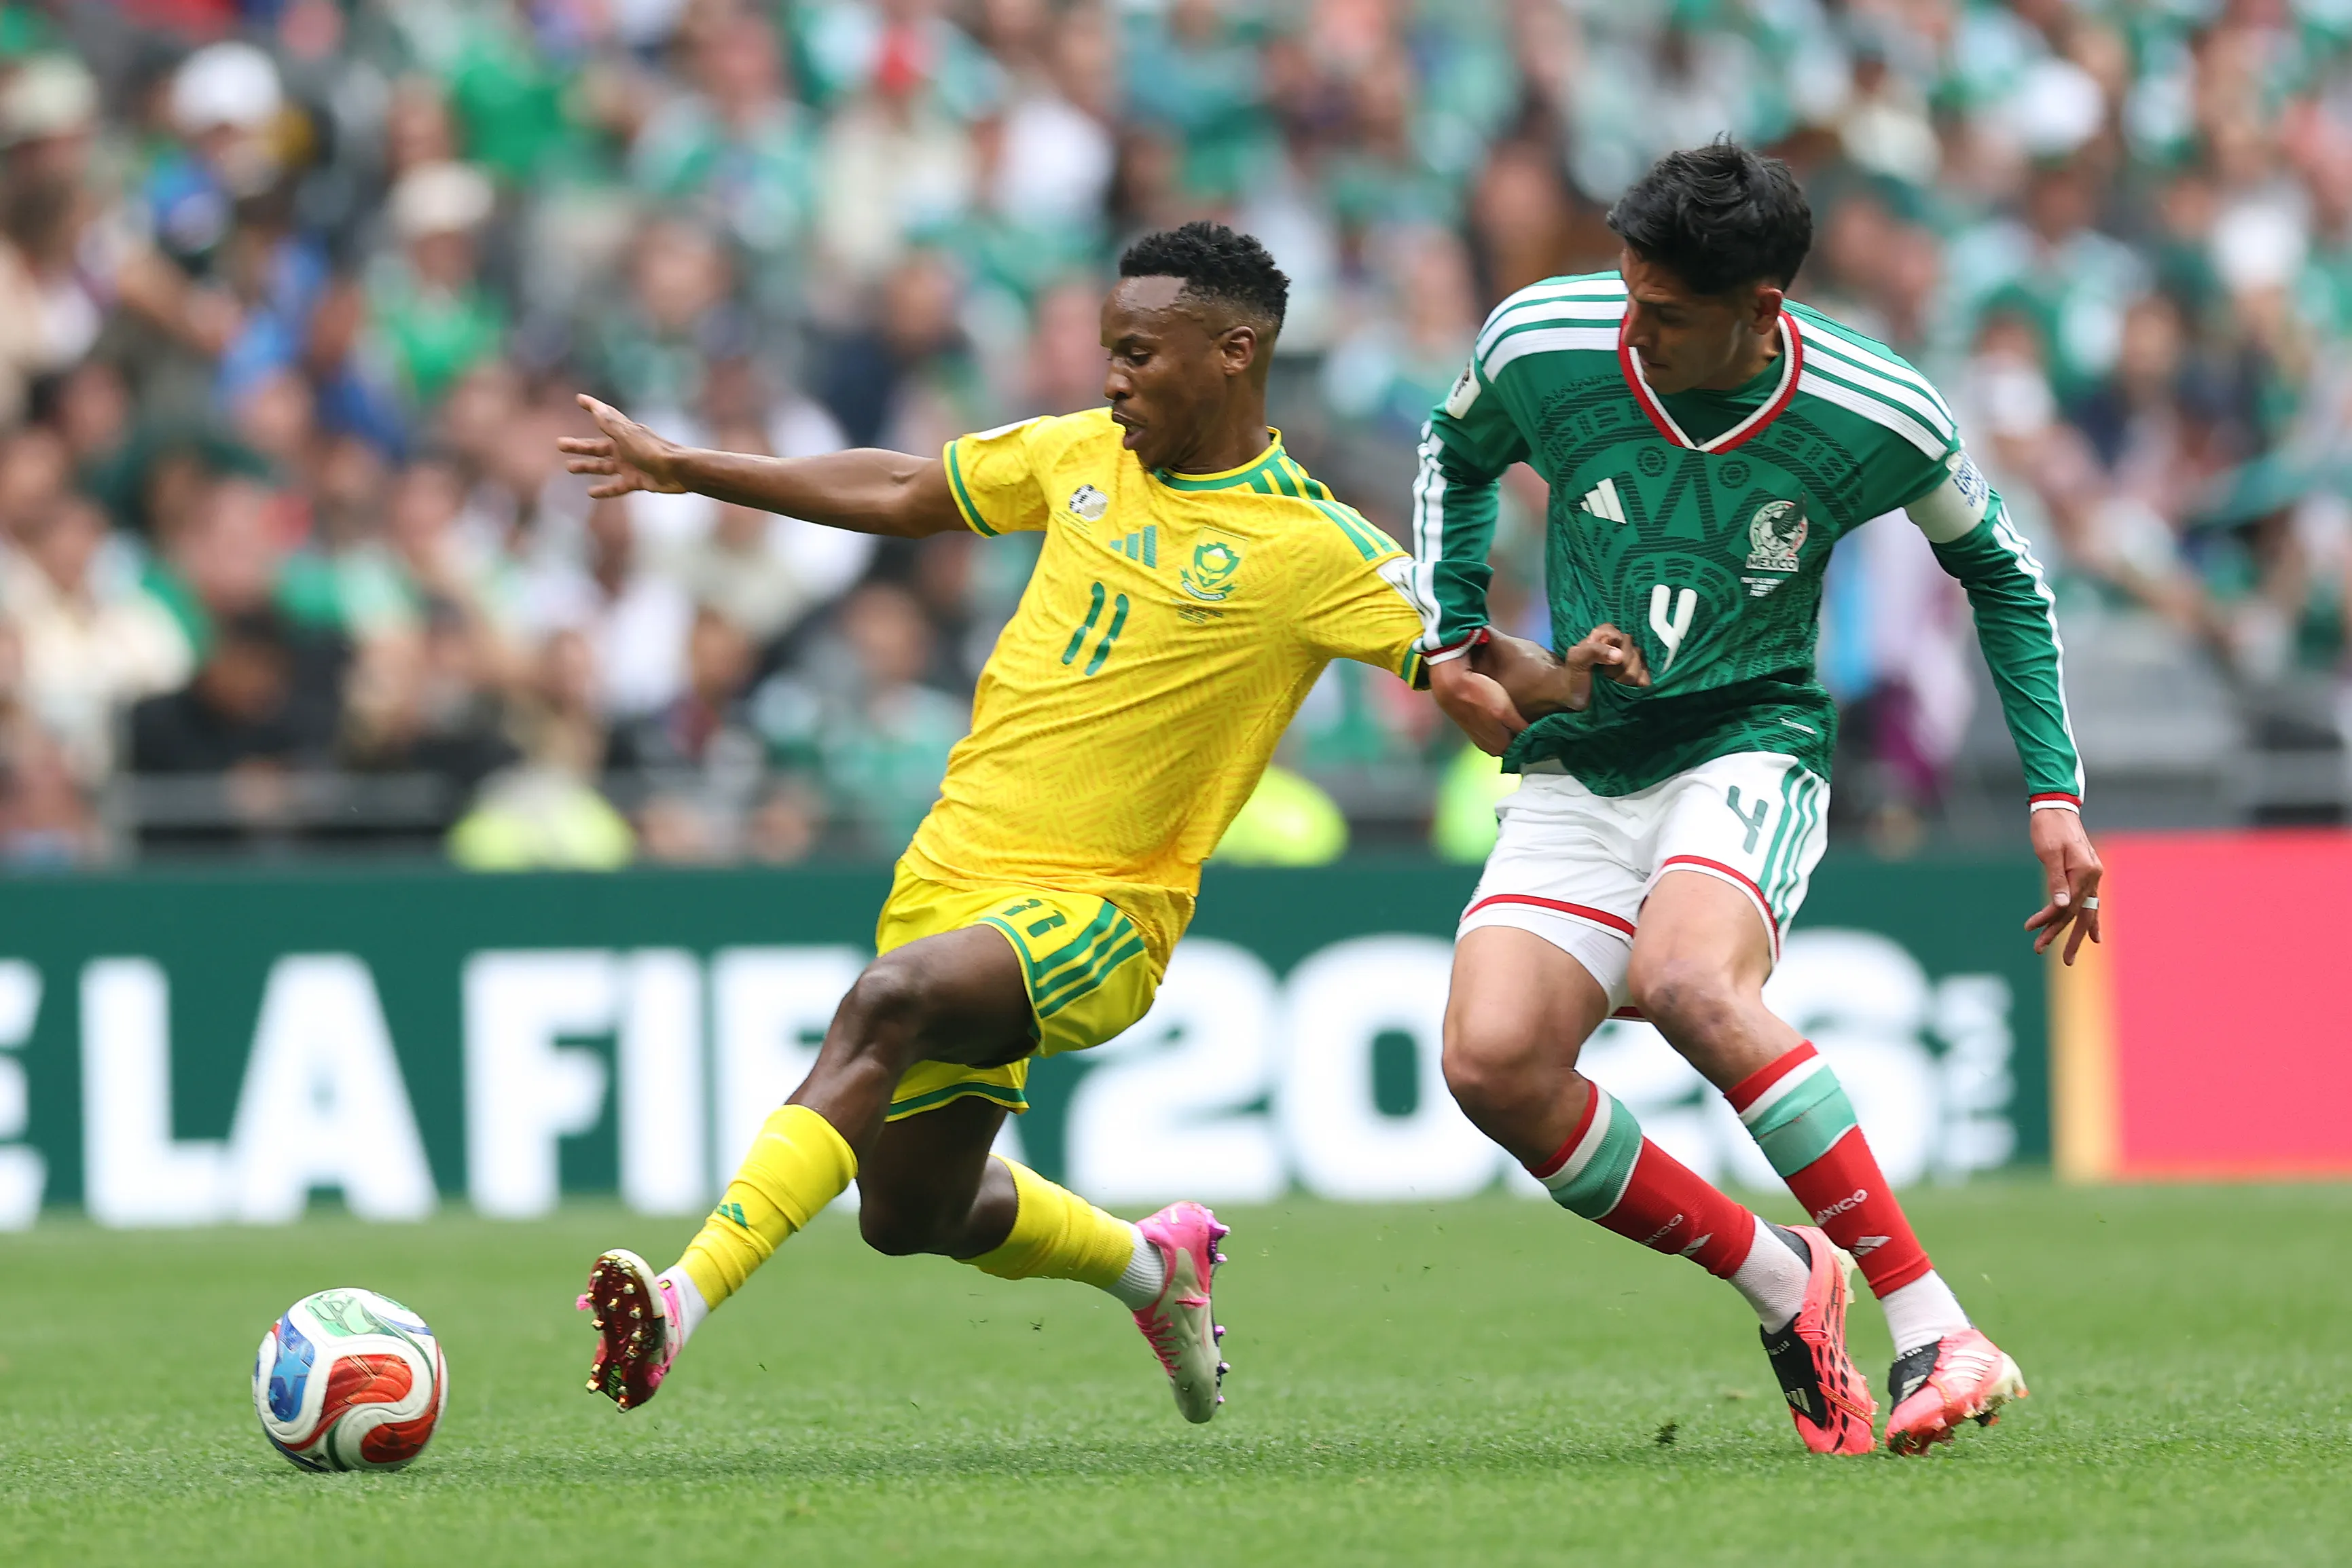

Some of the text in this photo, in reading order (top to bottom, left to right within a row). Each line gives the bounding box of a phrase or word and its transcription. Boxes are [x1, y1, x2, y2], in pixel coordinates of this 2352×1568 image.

[1062, 581, 1129, 676] 11
[1649, 584, 1698, 675] 4
[1726, 785, 1769, 855] 4
[1002, 898, 1066, 938] 11
[79, 953, 437, 1228] LA
[463, 947, 1029, 1220] FIF
